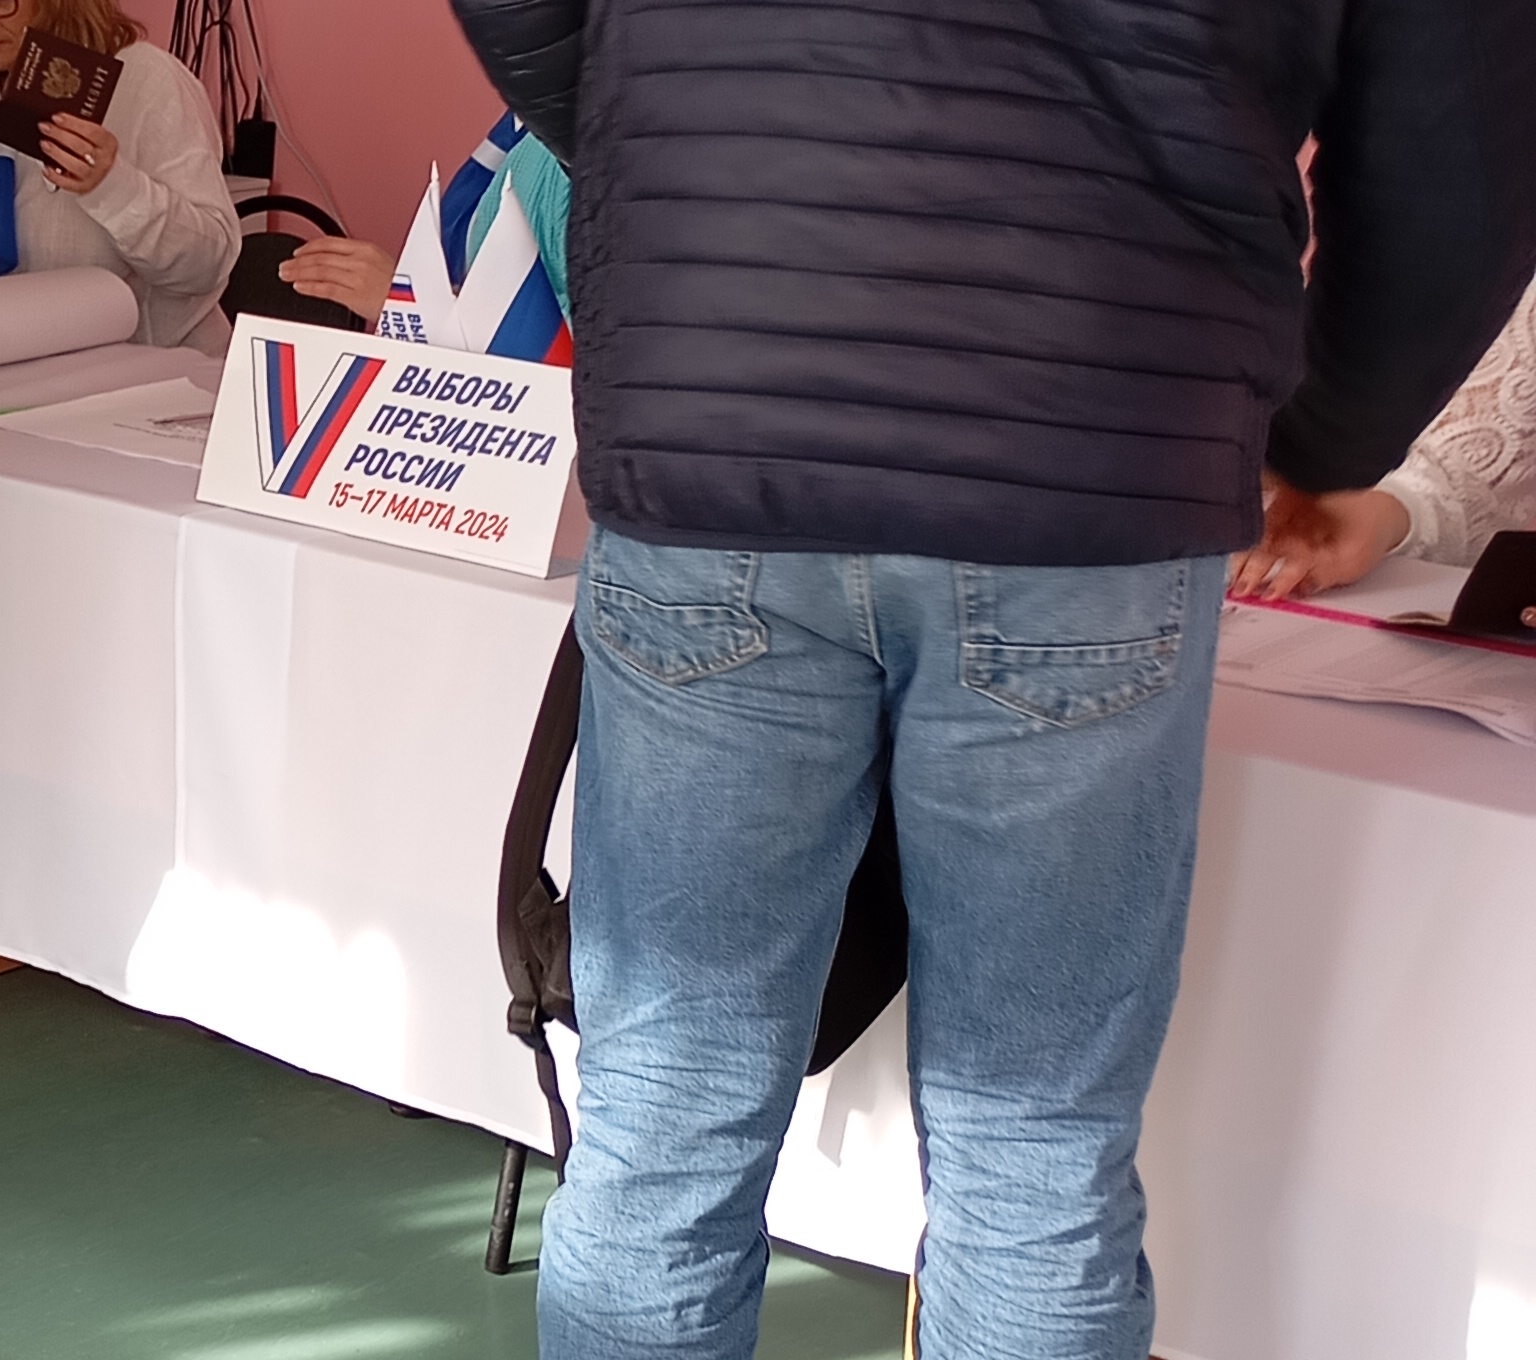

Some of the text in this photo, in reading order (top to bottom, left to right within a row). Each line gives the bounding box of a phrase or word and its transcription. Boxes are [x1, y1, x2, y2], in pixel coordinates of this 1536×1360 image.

[392, 365, 529, 413] ВЫБОРЫ
[368, 405, 557, 466] ПРЕЗИДЕНТА
[345, 444, 465, 492] РОССИИ
[383, 493, 456, 532] МАРТА
[455, 509, 510, 543] 2024
